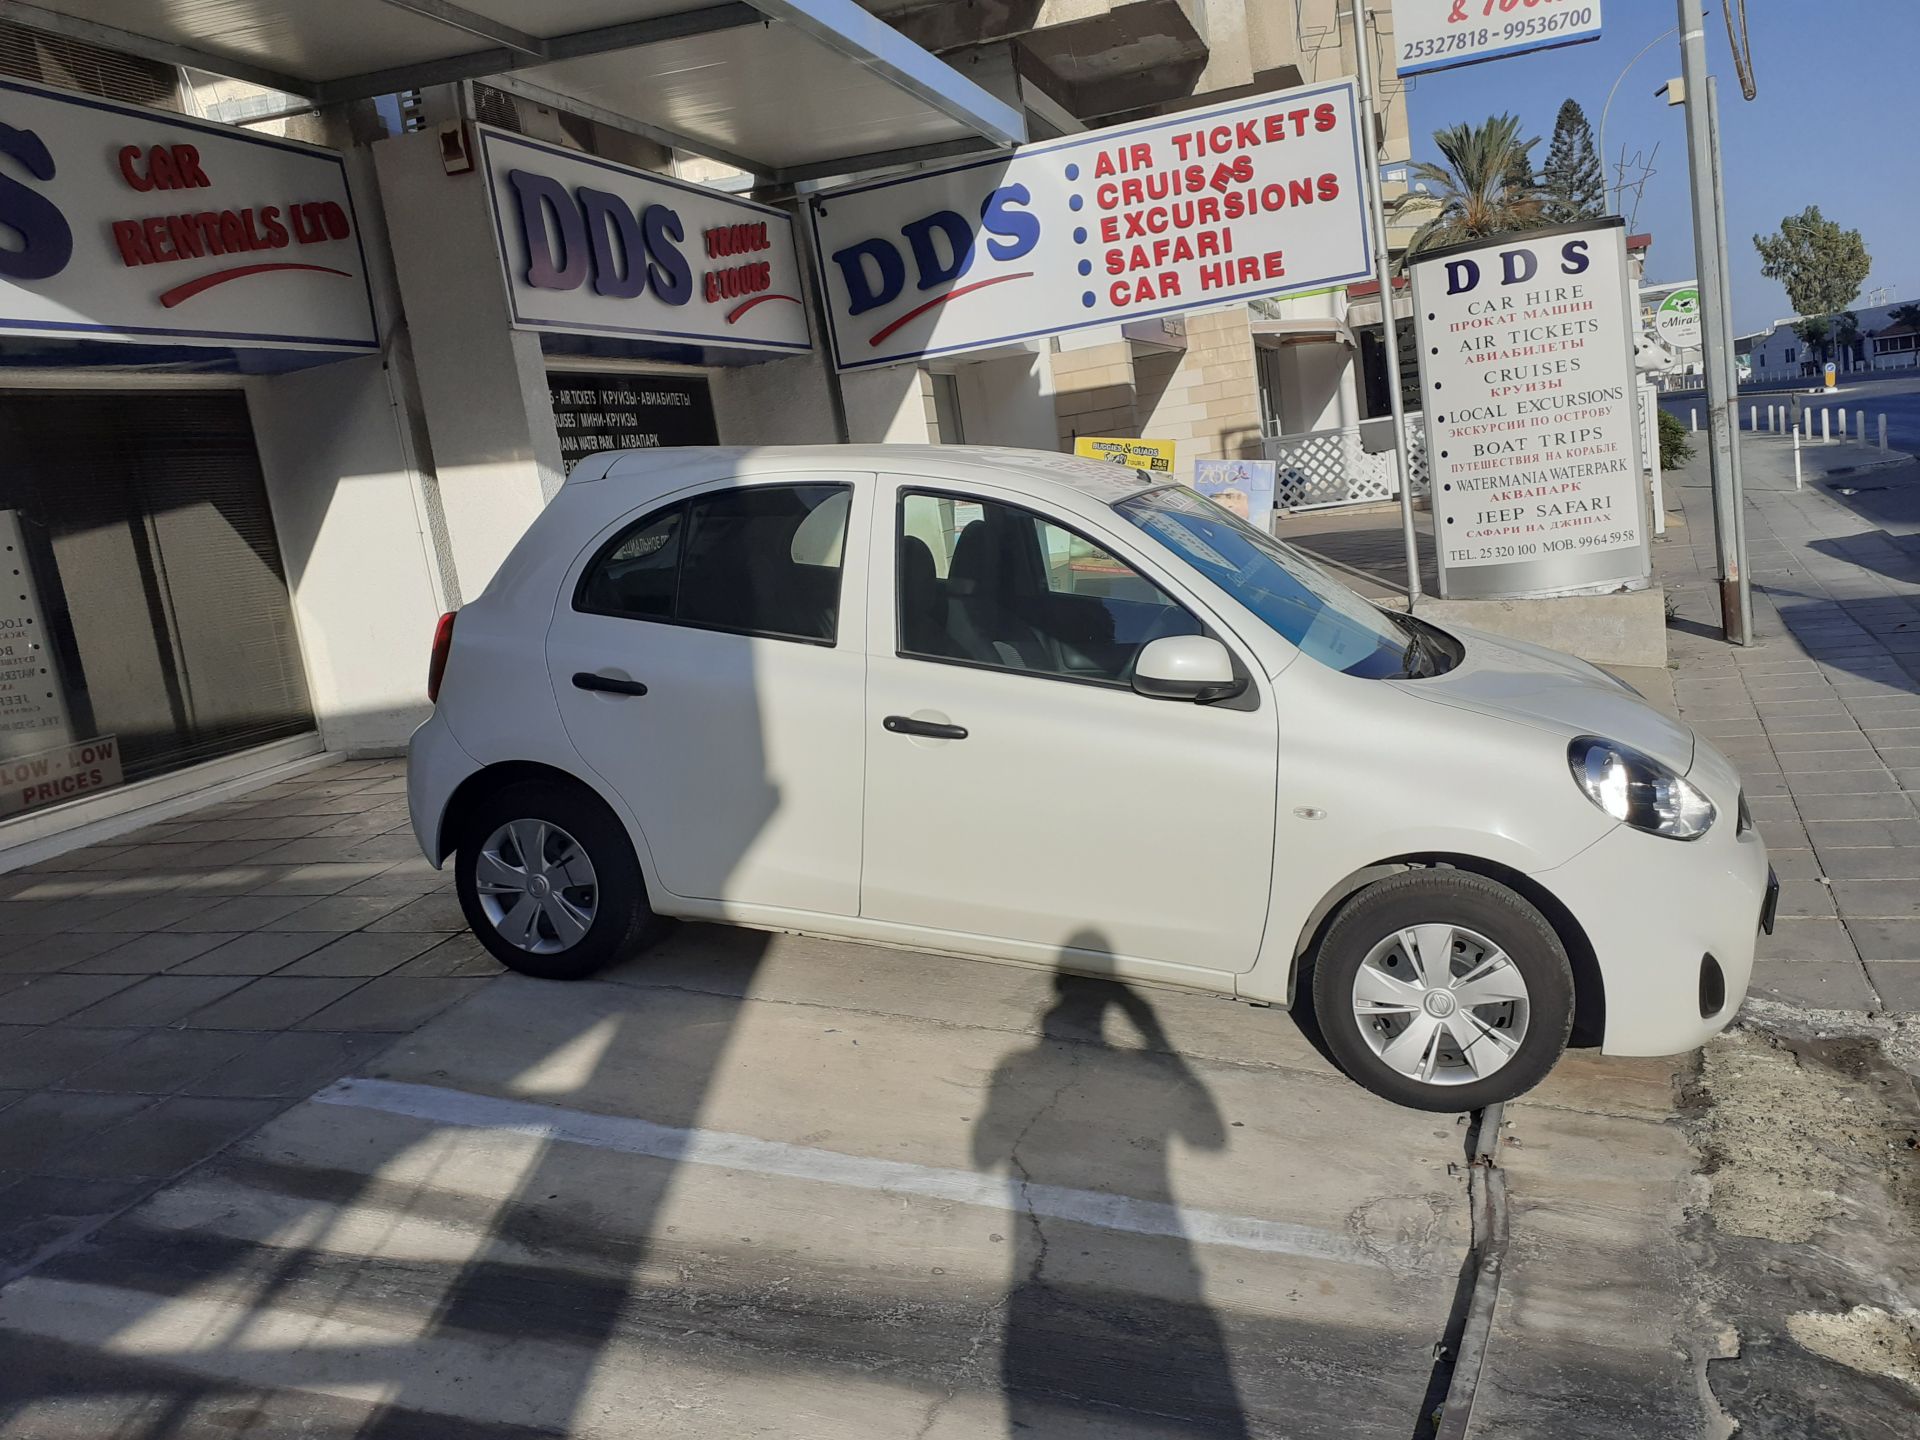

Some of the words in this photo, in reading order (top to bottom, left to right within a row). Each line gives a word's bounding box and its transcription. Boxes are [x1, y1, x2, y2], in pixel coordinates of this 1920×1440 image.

[1403, 28, 1488, 60] 25327818
[1504, 7, 1593, 41] 99536700
[1094, 142, 1153, 179] AIR
[1172, 103, 1337, 161] TICKETS
[119, 144, 211, 192] CAR
[1097, 155, 1254, 211] CRUISES
[1100, 173, 1340, 243] EXCURSIONS
[112, 206, 289, 267] RENTALS
[290, 201, 350, 244] LTD
[509, 169, 693, 306] DDS
[705, 221, 771, 259] TRAVEL
[831, 183, 1041, 316] DDS
[1106, 227, 1232, 275] SAFARI
[1109, 271, 1181, 306] CAR
[1201, 250, 1285, 291] HIRE
[1450, 313, 1517, 333] ПРОКАТ
[1523, 300, 1594, 320] МАШИН
[1468, 296, 1514, 316] CAR
[1526, 285, 1584, 306] HIRE
[1459, 335, 1496, 353] AIR
[1508, 319, 1599, 344] TICKETS
[1464, 338, 1585, 365] АВИАБИЛЕТЫ
[1484, 358, 1581, 385] CRUISES
[1490, 378, 1563, 398] КРУИЗЫ
[1448, 419, 1525, 438] ЭКСКУРСИИ
[1530, 415, 1550, 427] ПО
[1554, 405, 1613, 424] ОСТРОВУ
[1450, 405, 1507, 424] LOCAL
[1517, 386, 1623, 415] EXCURSIONS
[1092, 442, 1123, 452] BUGGIES
[1133, 446, 1159, 457] QUADS
[1450, 453, 1540, 473] ПУТЕШЕСТВИЯ
[1546, 451, 1562, 461] НА
[1566, 442, 1618, 459] КОРАБЛЕ
[1473, 437, 1528, 457] BOAT
[1538, 427, 1603, 448] TRIPS
[1456, 469, 1548, 492] WATERMANIA
[1549, 458, 1628, 480] WATERPARK
[1489, 481, 1583, 503] АКВАПАРК
[1466, 526, 1521, 539] САФАРИ
[1526, 523, 1545, 533] НА
[1550, 513, 1613, 530] ДЖИПАХ
[1476, 507, 1525, 525] JEEP
[1536, 496, 1612, 518] SAFARI
[1450, 550, 1477, 561] TEL.
[1542, 539, 1577, 553] MOB.
[1, 759, 48, 786] LOW
[68, 742, 113, 768] LOW
[22, 769, 102, 804] PRICES
